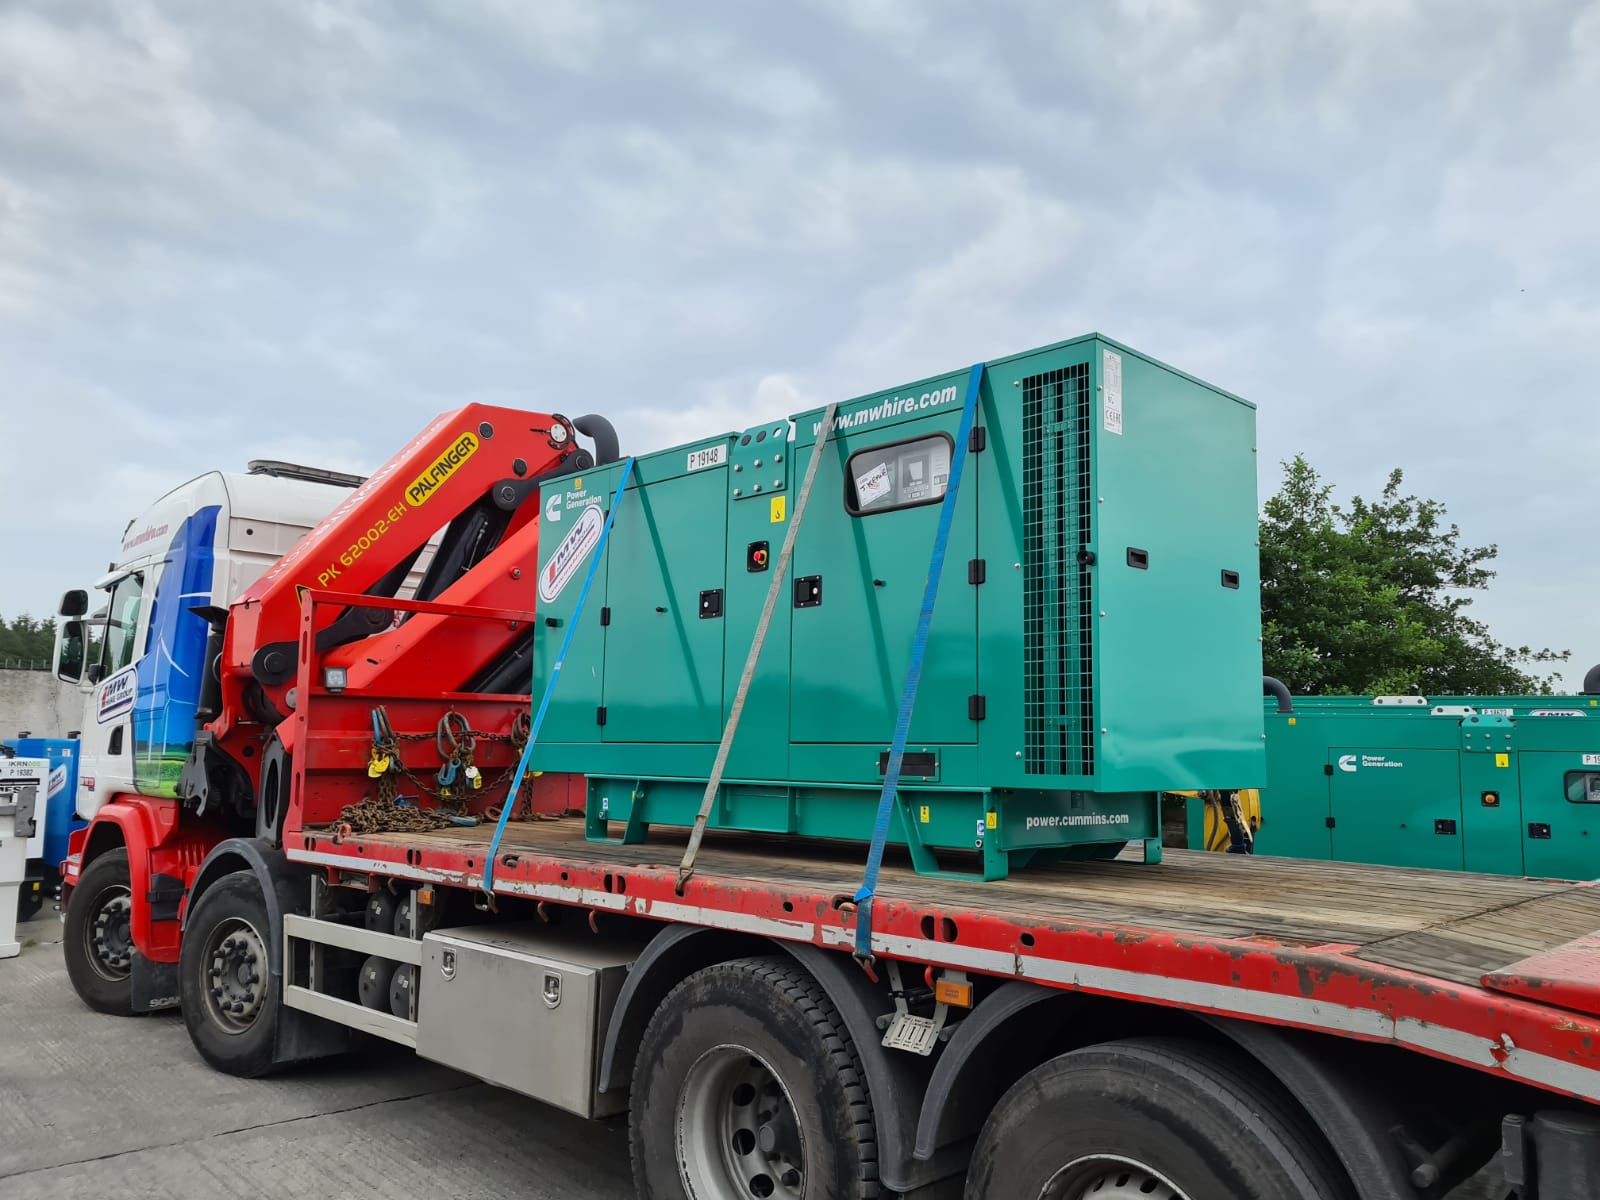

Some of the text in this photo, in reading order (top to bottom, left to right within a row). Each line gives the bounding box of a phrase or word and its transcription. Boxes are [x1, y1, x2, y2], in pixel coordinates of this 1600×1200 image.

[408, 435, 476, 503] PALFINGER
[690, 448, 718, 469] P 19148
[566, 490, 587, 501] Power
[566, 495, 602, 510] Generation
[317, 502, 408, 588] PK 62002-EH
[557, 521, 585, 565] MW
[107, 675, 129, 697] MW
[1361, 760, 1403, 768] Generation
[1026, 811, 1129, 831] power.cummins.com
